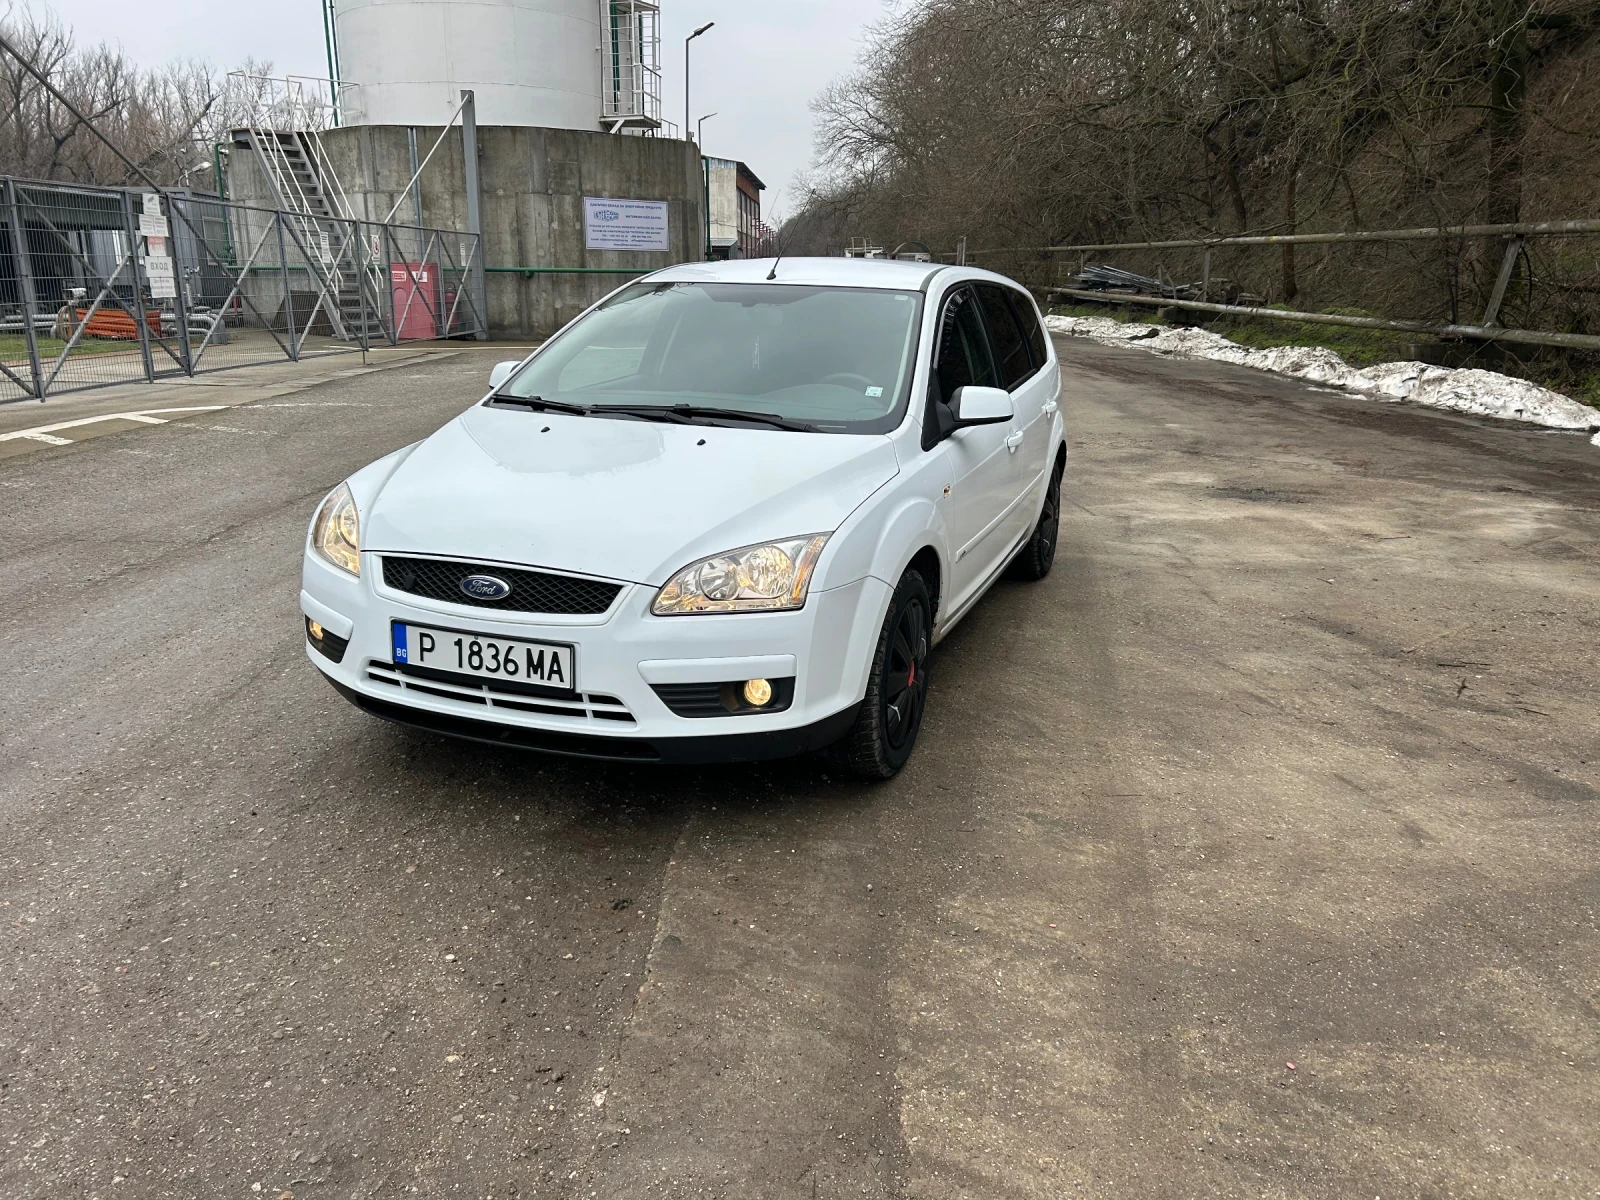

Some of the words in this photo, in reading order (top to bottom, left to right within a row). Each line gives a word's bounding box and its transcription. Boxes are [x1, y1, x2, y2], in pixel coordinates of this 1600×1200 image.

[151, 262, 169, 272] ВХОД
[469, 579, 496, 595] Ford
[396, 647, 407, 658] BG
[418, 631, 436, 662] P
[453, 637, 519, 676] 1836
[526, 647, 565, 683] MA
